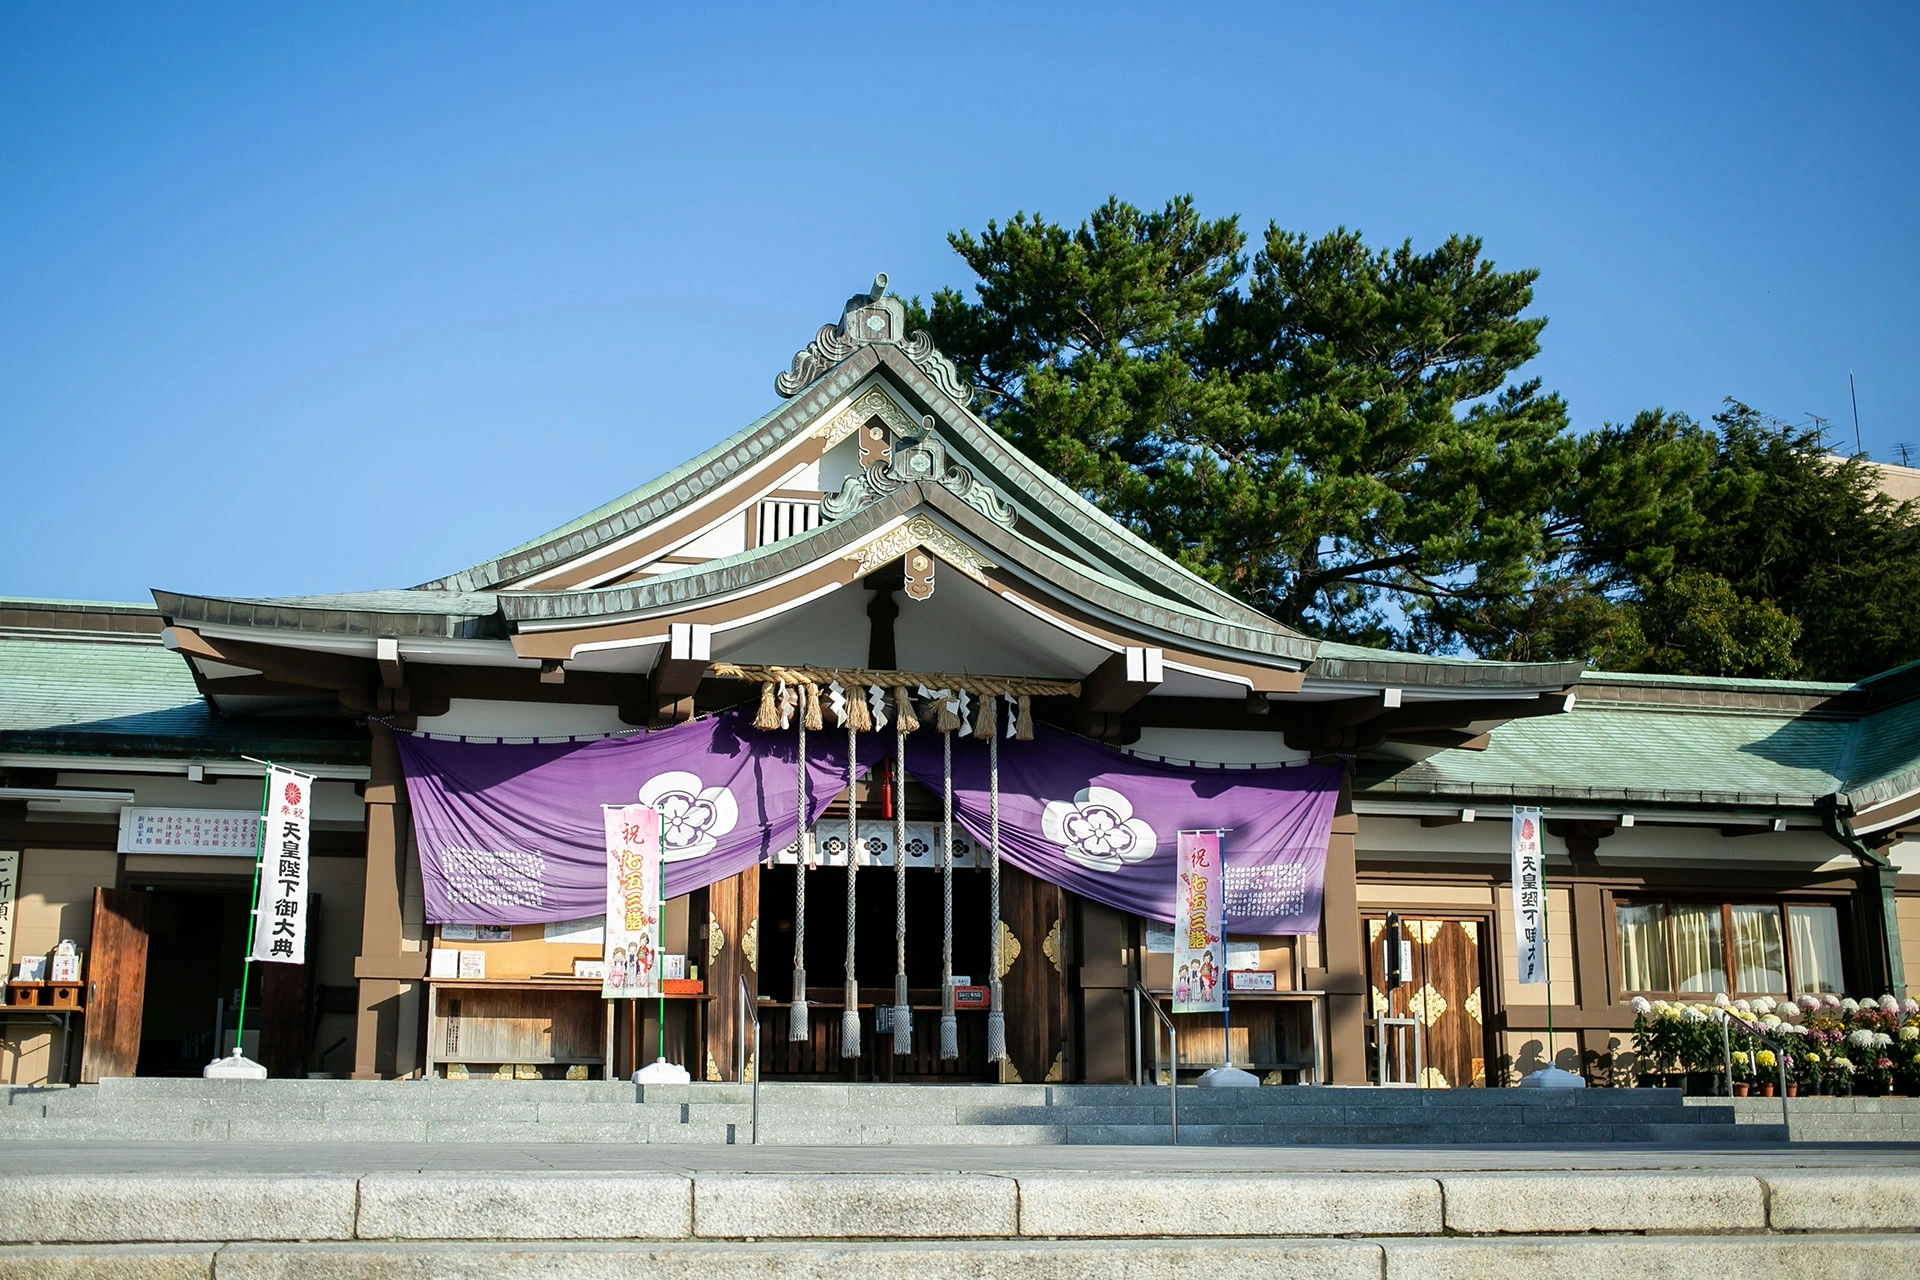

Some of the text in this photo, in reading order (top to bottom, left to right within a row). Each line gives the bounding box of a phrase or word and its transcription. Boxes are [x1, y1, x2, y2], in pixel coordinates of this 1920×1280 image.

[280, 805, 305, 819] 奉祝
[621, 822, 645, 845] 祝
[1191, 848, 1210, 868] 祝
[270, 821, 301, 958] 天皇陛下御大典
[624, 851, 644, 931] 七五三詣
[1188, 874, 1208, 949] 七五三詣
